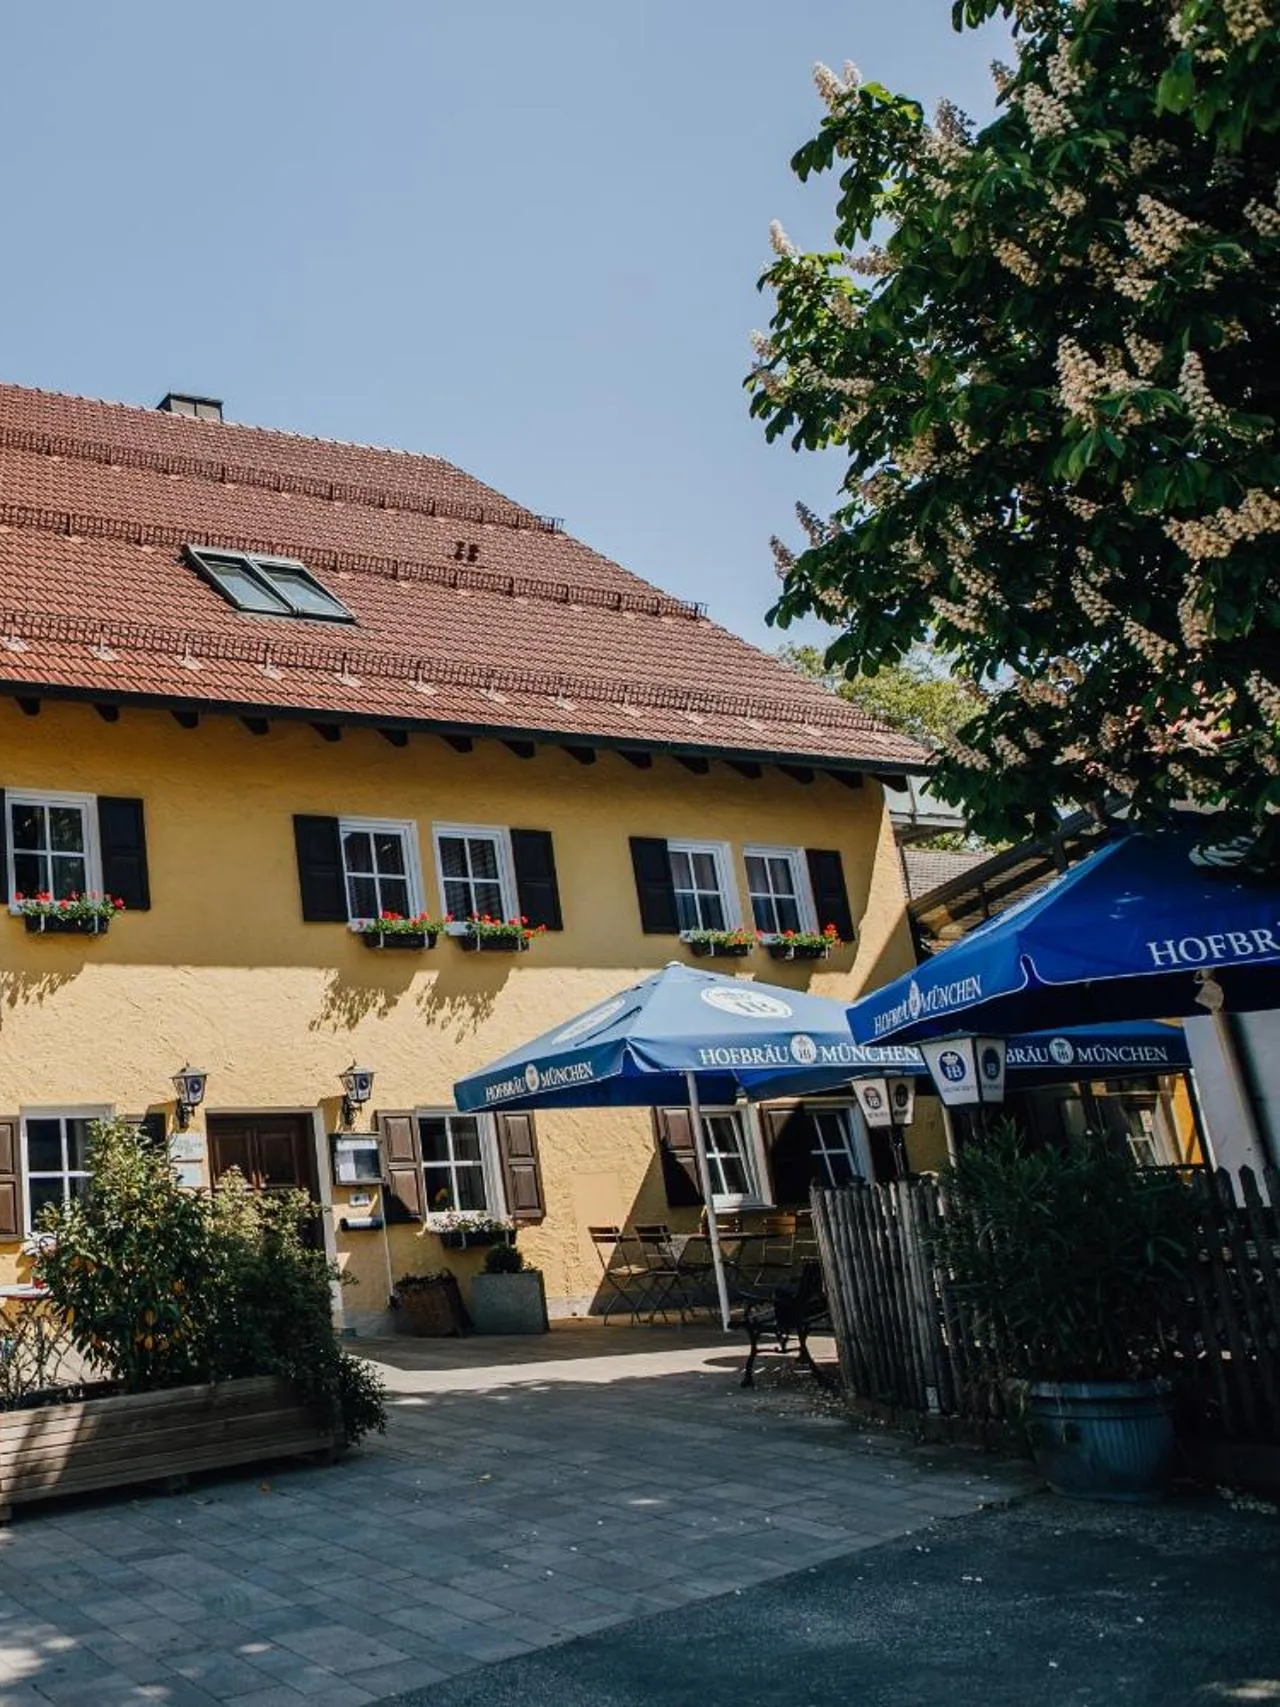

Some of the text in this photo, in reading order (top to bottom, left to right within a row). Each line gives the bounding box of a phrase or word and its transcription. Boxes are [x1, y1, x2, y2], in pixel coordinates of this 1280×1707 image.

[1146, 920, 1280, 967] HOFBR
[919, 974, 983, 1014] MÜNCHEN
[699, 1043, 921, 1066] HOFBRÄU MÜNCHEN
[1005, 1044, 1169, 1063] BRÄU MÜNCHEN
[485, 1061, 595, 1102] HOFBRÄU MÜNCHEN
